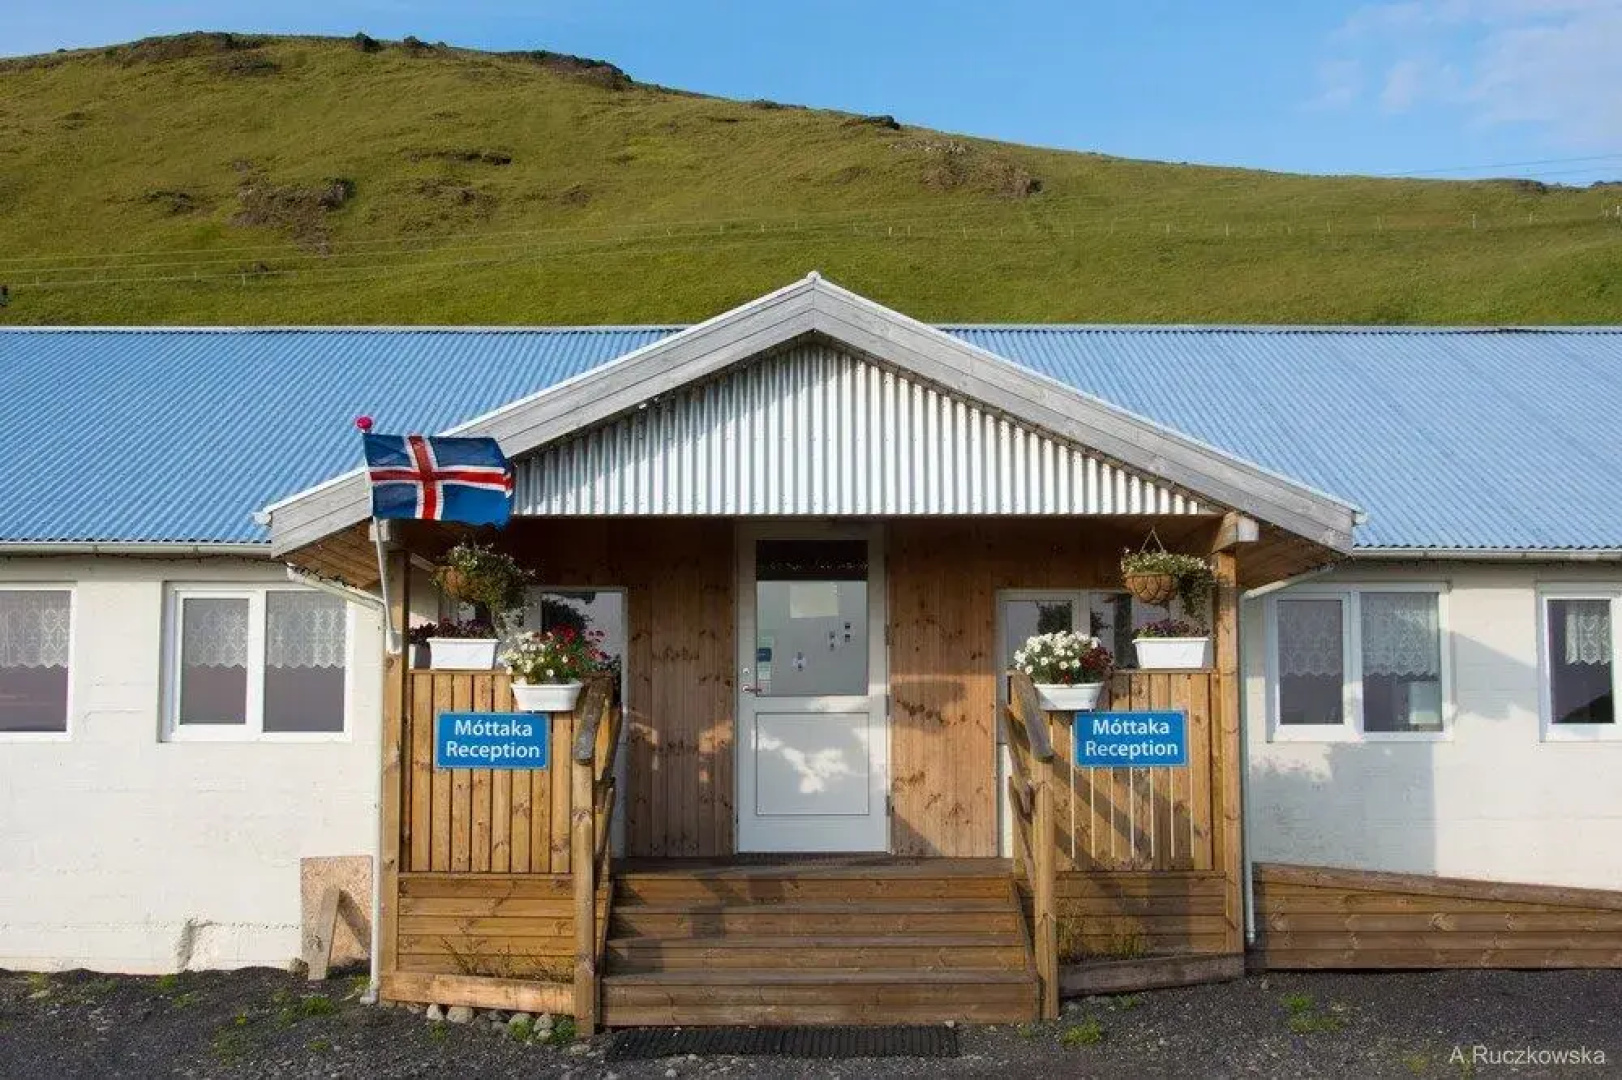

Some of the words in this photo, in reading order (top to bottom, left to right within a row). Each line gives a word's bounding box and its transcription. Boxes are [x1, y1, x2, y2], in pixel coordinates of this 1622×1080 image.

[454, 719, 533, 737] Móttaka
[1092, 718, 1170, 736] Móttaka
[446, 740, 540, 762] Reception
[1086, 740, 1179, 760] Reception
